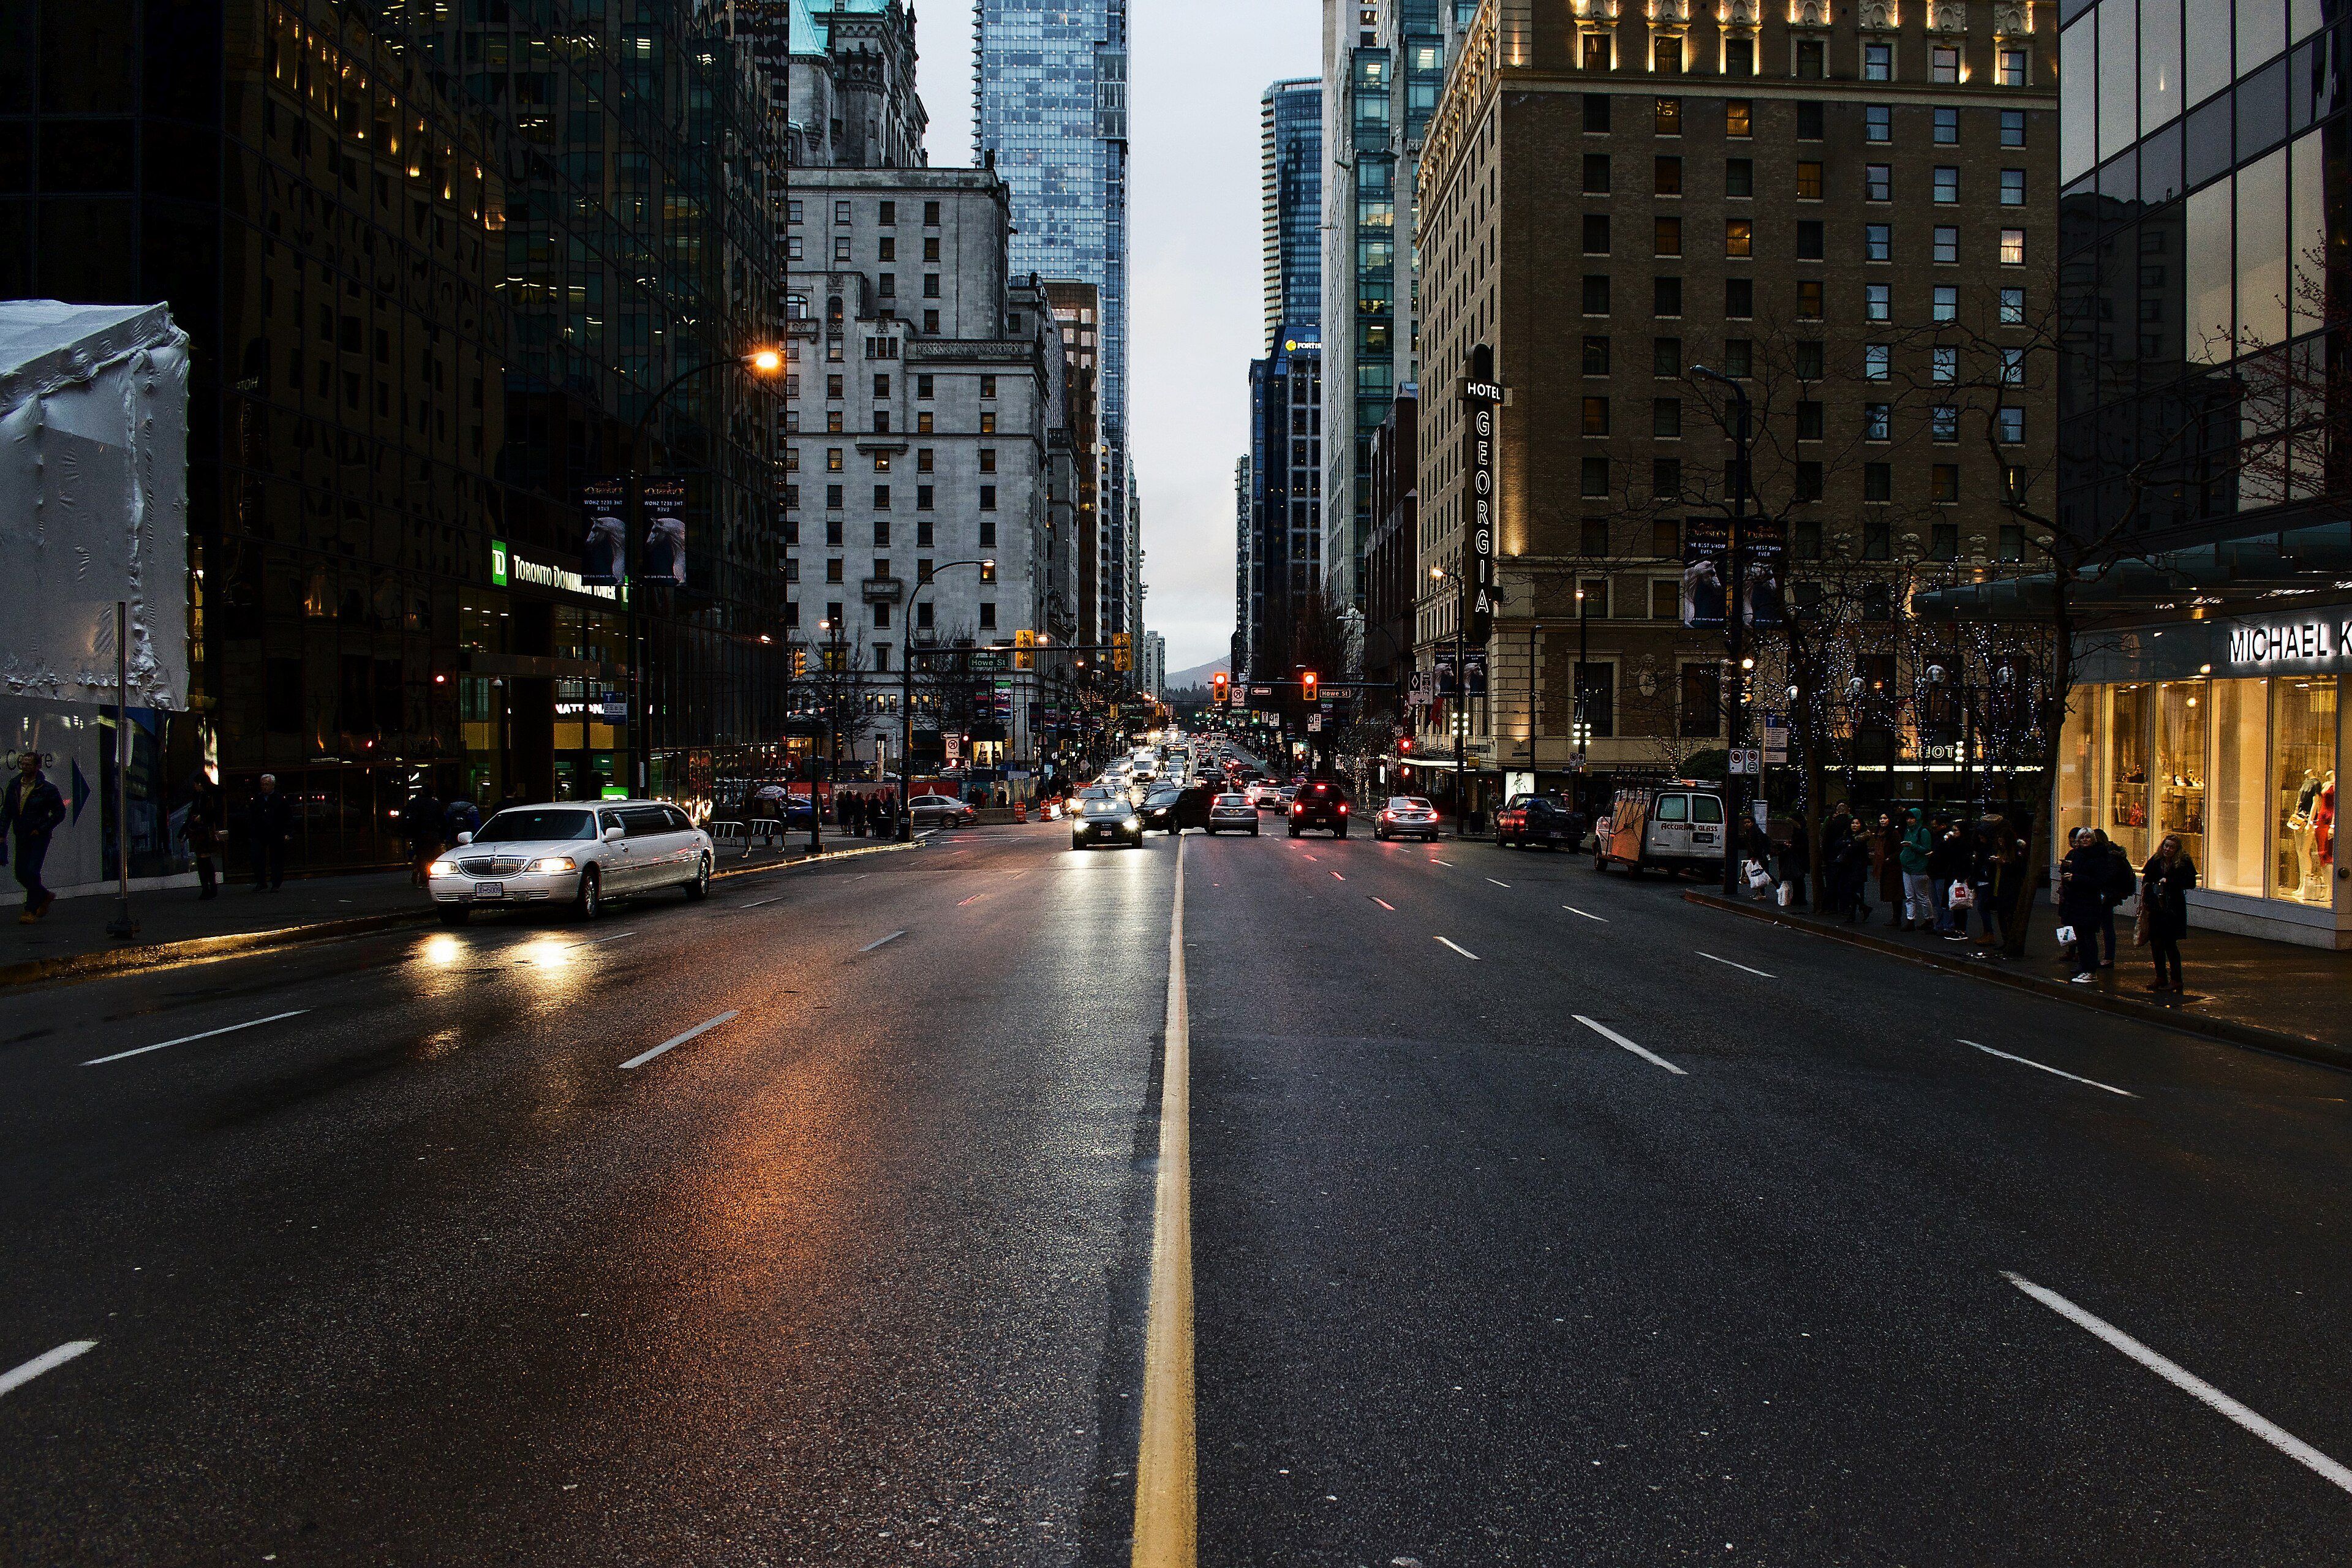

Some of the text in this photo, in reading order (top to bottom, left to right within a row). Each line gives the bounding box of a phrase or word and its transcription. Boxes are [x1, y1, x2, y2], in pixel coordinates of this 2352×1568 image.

[1468, 382, 1501, 400] HOTEL
[1476, 411, 1490, 613] GEORGIA
[513, 554, 552, 586] TORONTO
[2228, 624, 2327, 663] MICHAEL
